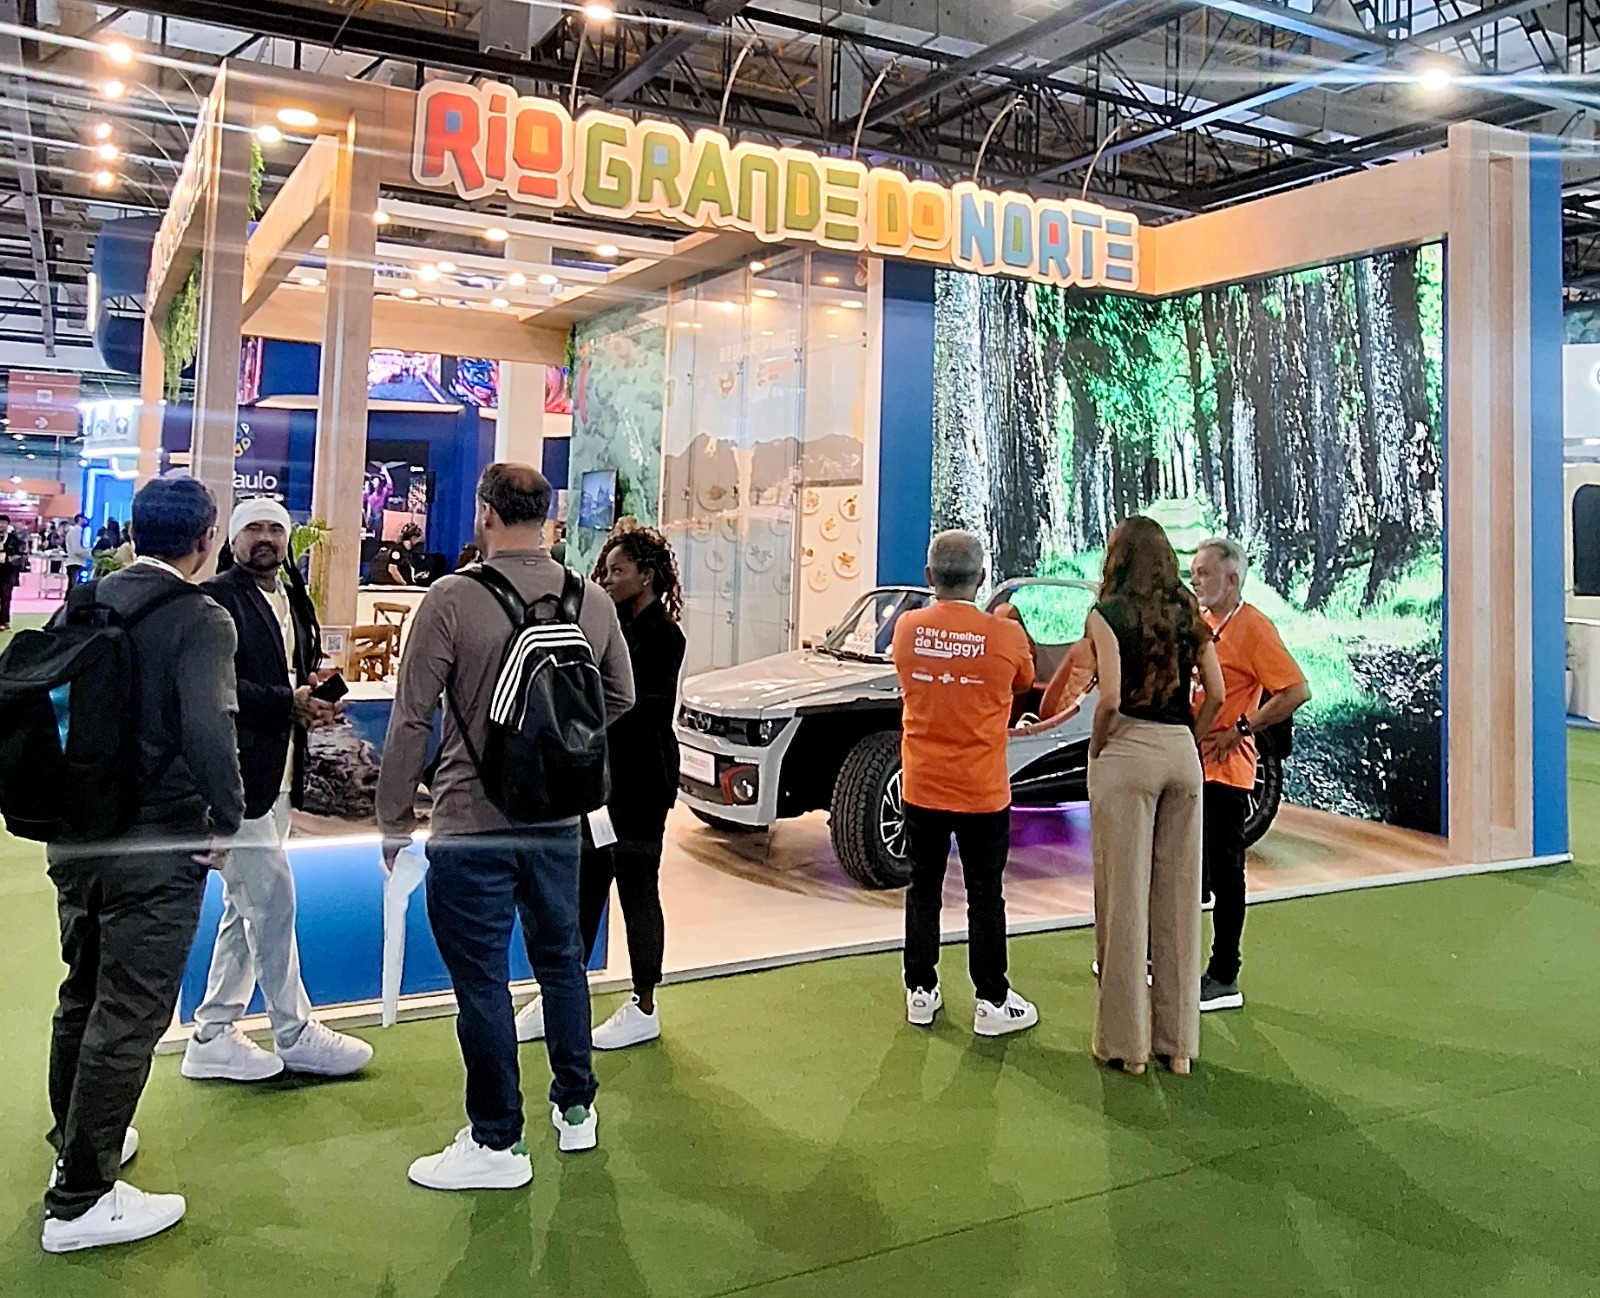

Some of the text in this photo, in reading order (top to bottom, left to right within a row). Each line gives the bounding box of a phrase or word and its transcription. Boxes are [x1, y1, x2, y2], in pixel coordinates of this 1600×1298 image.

[582, 122, 861, 243] GRANDE
[876, 179, 945, 247] DO
[960, 192, 1134, 282] NORTE
[232, 470, 278, 490] aulo
[916, 626, 925, 635] O
[925, 628, 940, 638] RN
[949, 631, 986, 643] melhor
[915, 636, 932, 647] de
[934, 639, 985, 658] buggy!
